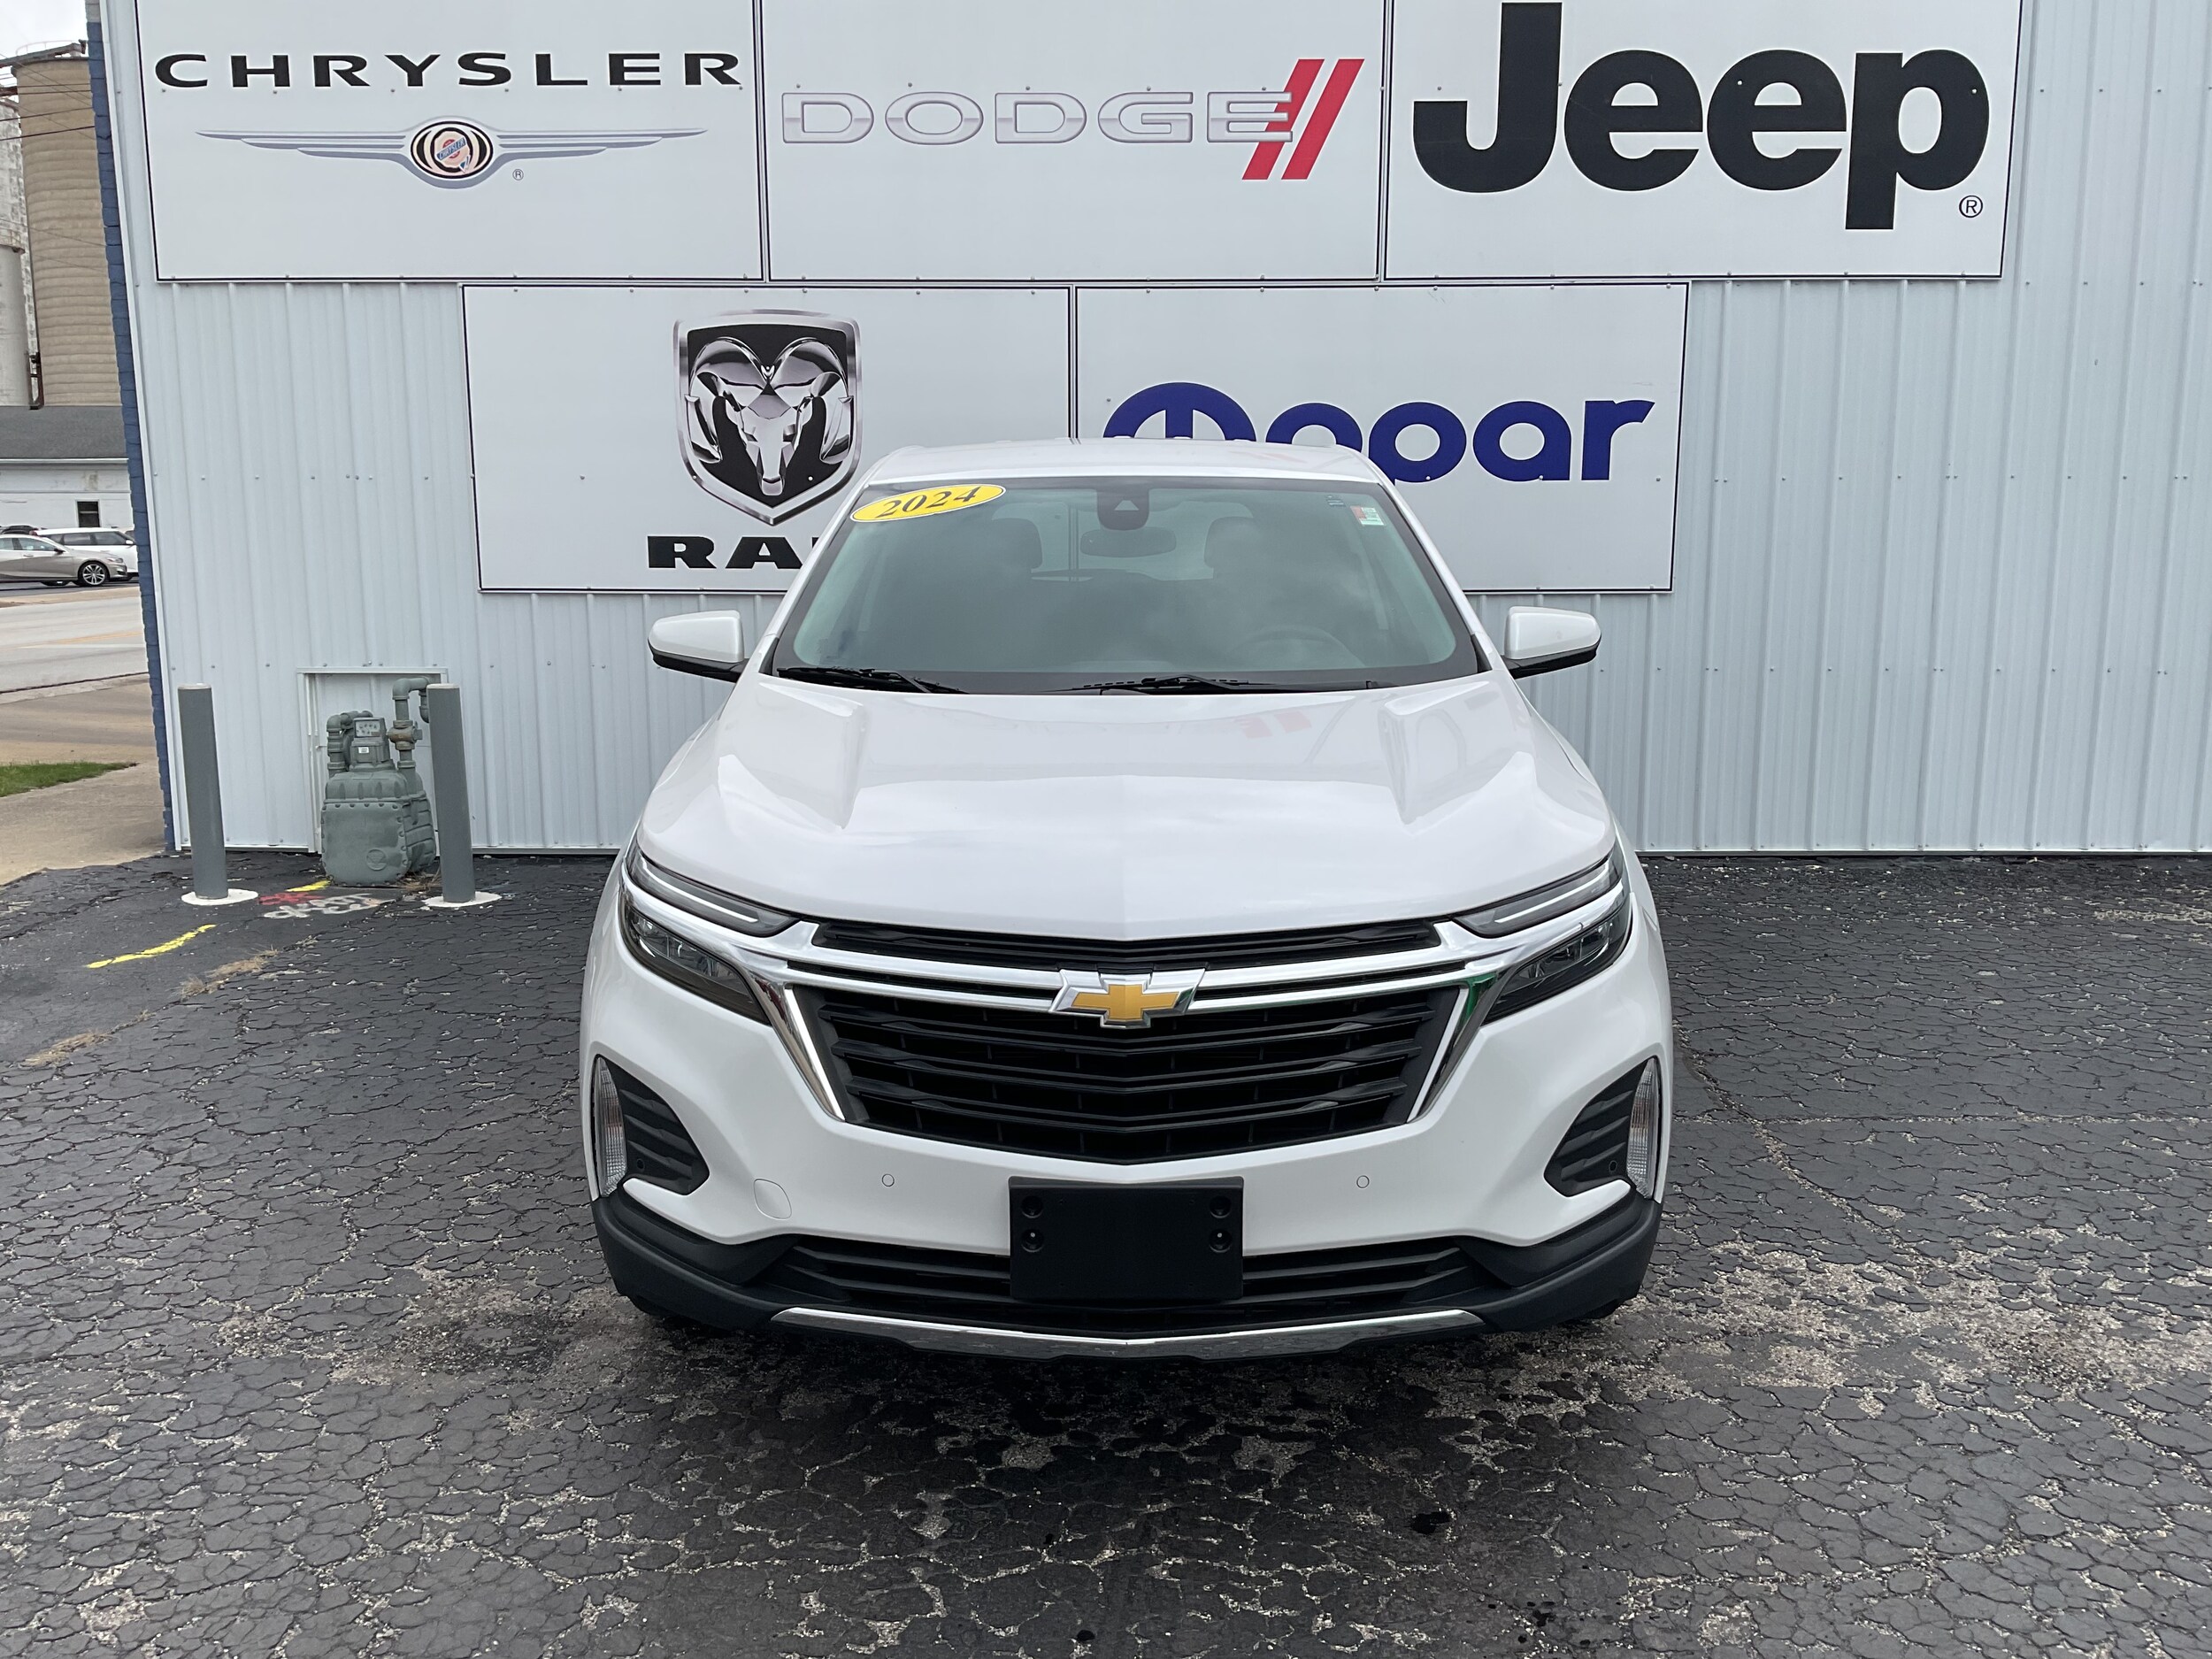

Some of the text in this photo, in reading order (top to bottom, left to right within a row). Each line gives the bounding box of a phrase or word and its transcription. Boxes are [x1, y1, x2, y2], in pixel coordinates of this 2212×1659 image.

[155, 53, 741, 88] CHRYSLER
[782, 91, 1293, 144] DODGE
[1413, 2, 1989, 229] Jeep
[875, 486, 981, 518] 2024
[647, 536, 819, 569] RA
